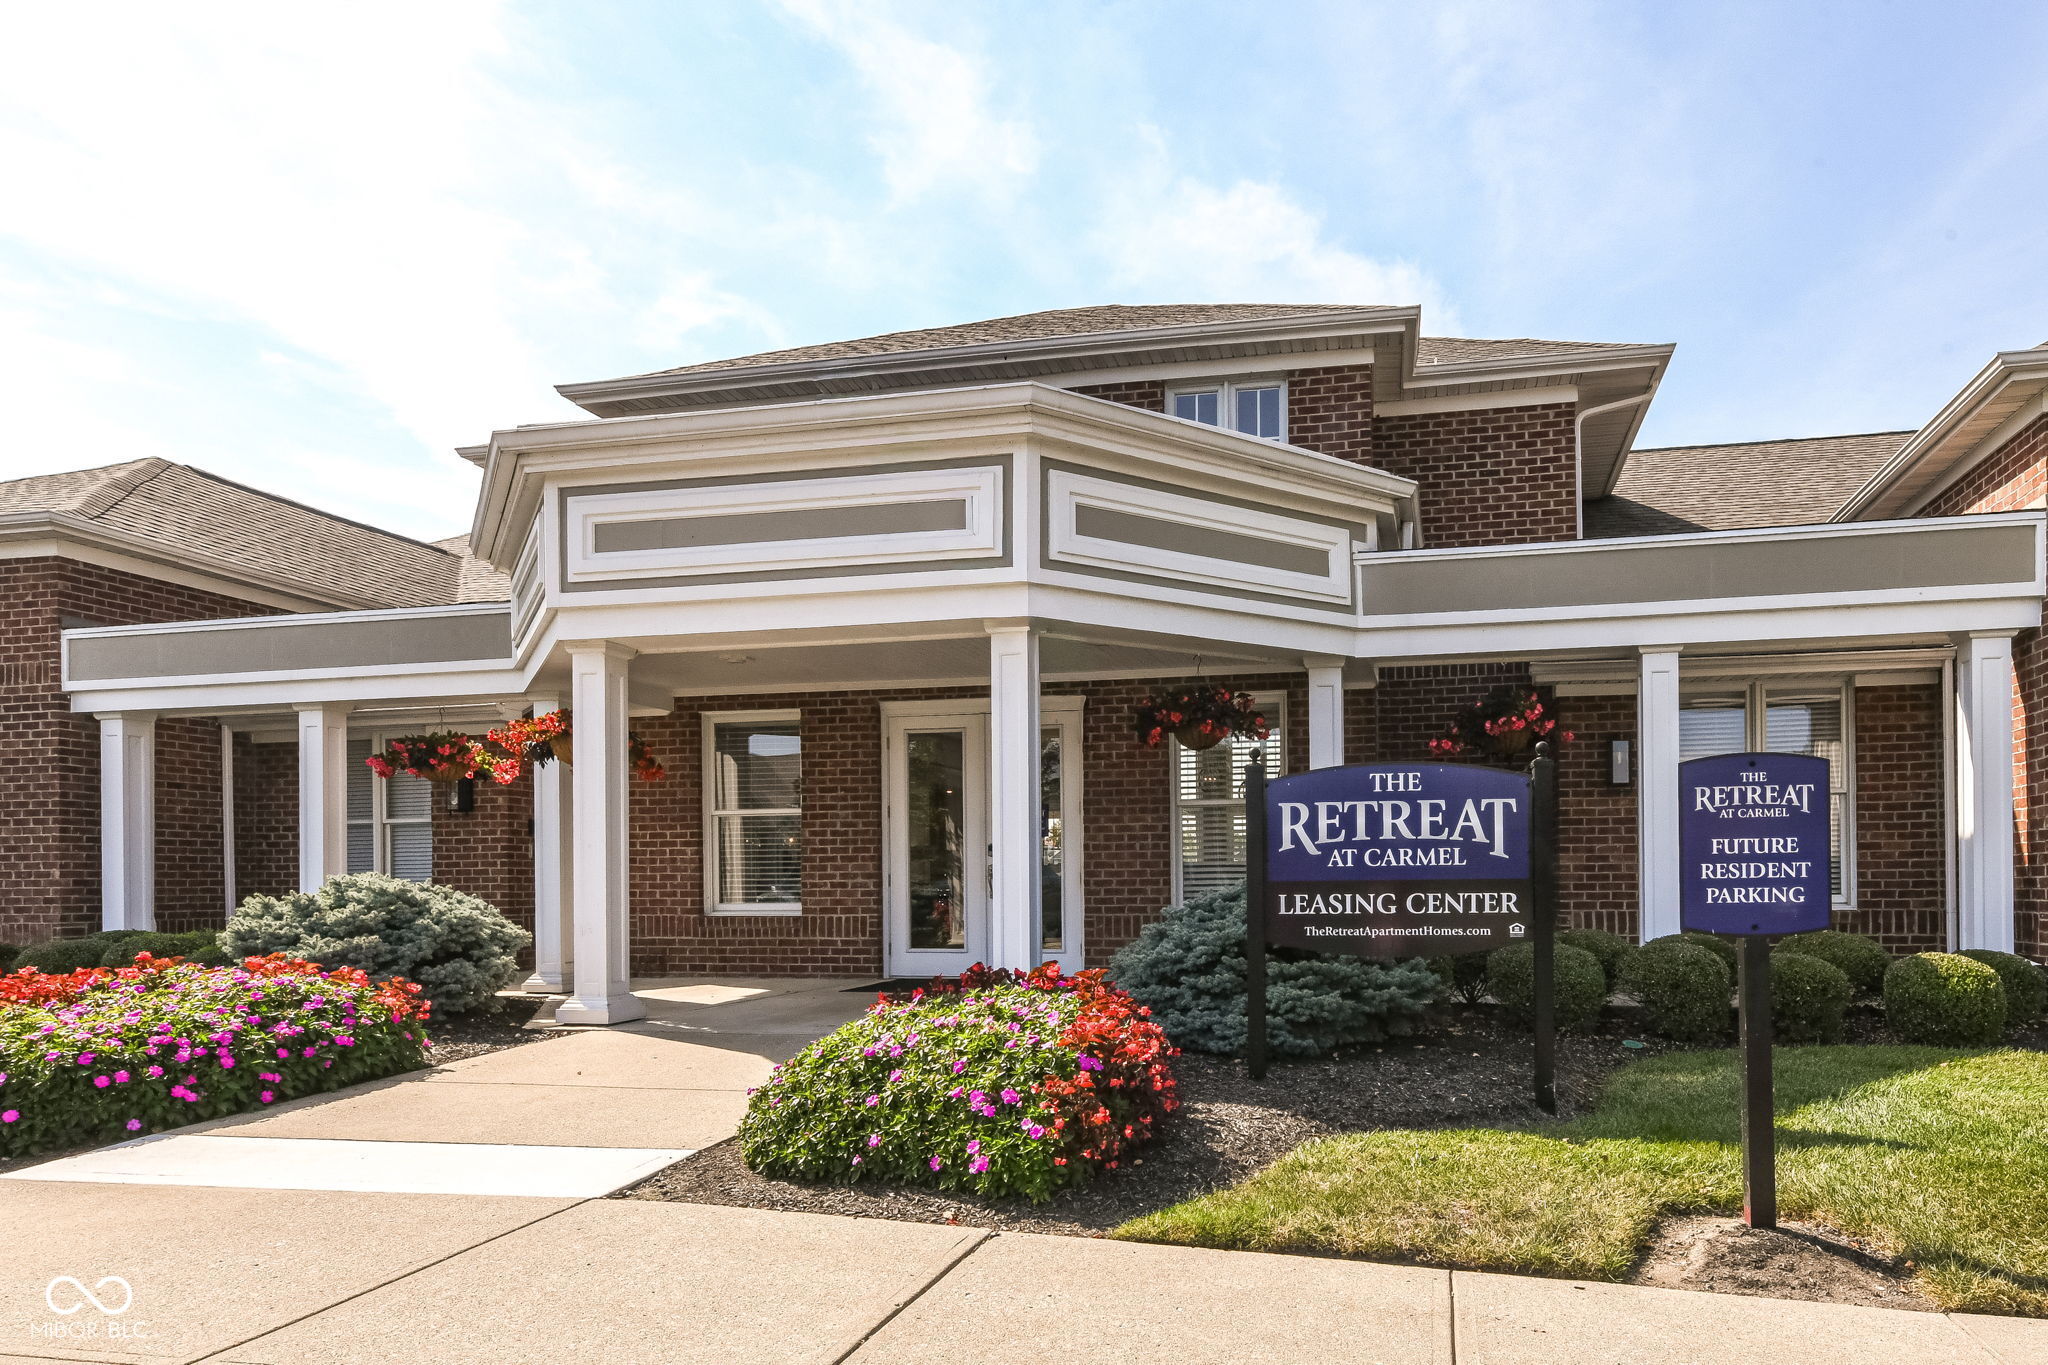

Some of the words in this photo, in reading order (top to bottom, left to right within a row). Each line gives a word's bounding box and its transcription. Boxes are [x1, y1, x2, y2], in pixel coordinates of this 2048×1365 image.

[1369, 772, 1422, 792] THE
[1740, 771, 1768, 782] THE
[1694, 784, 1814, 814] RETREAT
[1719, 808, 1735, 818] AT
[1737, 808, 1790, 818] CARMEL
[1278, 798, 1517, 859] RETREAT
[1711, 837, 1799, 855] FUTURE
[1327, 849, 1357, 867] AT
[1364, 847, 1467, 867] CARMEL
[1700, 861, 1811, 879] RESIDENT
[1278, 893, 1397, 915] LEASING
[1406, 892, 1520, 914] CENTER
[1706, 886, 1806, 904] PARKING
[1304, 926, 1492, 939] TheRetreatApartmentHomes.com
